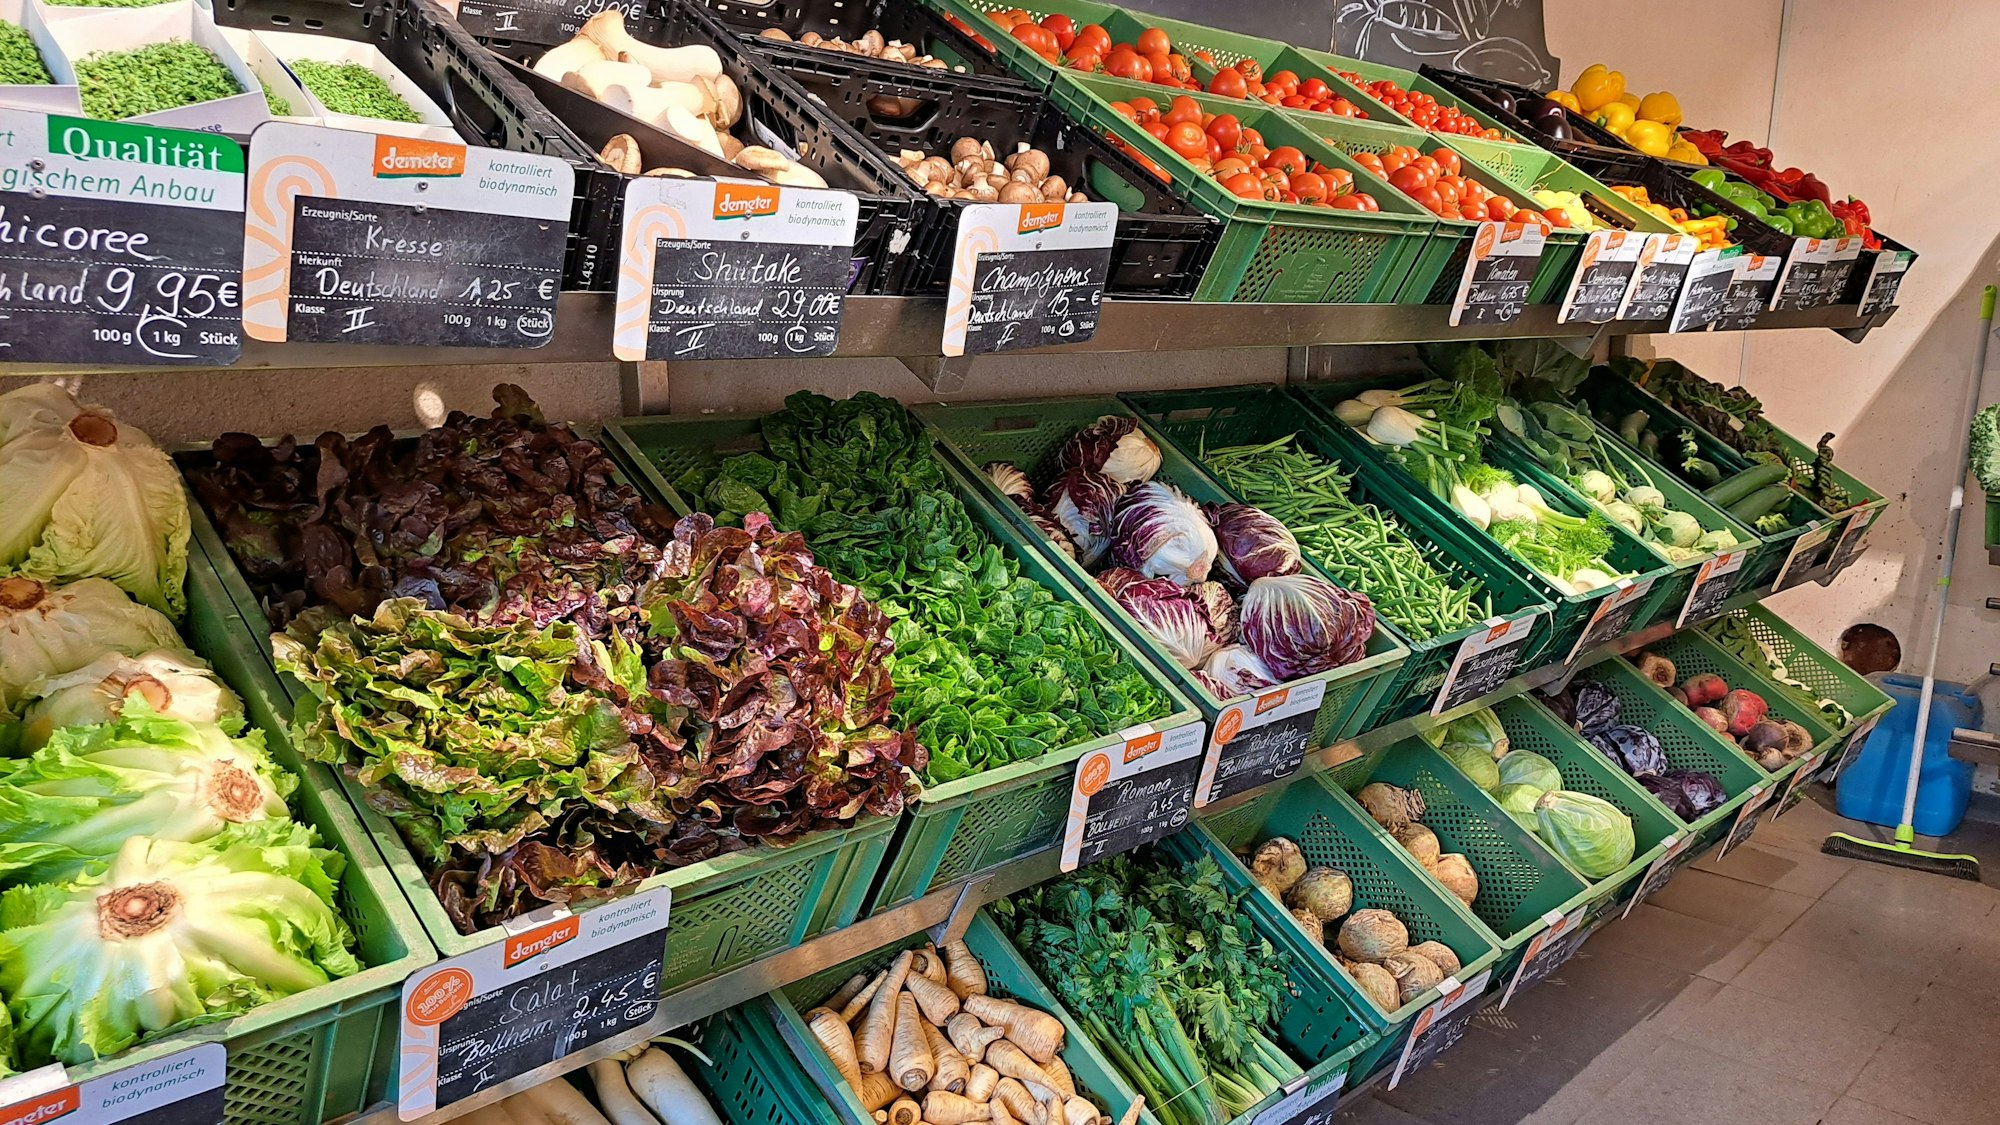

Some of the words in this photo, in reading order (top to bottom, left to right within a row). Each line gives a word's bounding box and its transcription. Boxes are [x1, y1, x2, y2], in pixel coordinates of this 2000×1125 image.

[462, 5, 483, 16] Klasse
[63, 126, 223, 172] Qualität
[380, 147, 455, 171] demeter
[488, 160, 553, 178] kontrolliert
[129, 174, 215, 203] Anbau
[479, 177, 558, 197] biodynamisch
[719, 193, 772, 213] demeter
[795, 199, 843, 211] kontrolliert
[302, 206, 378, 222] Erzeugnis/Sorte
[788, 214, 846, 227] biodynamisch
[1021, 211, 1059, 228] demeter
[1074, 211, 1107, 220] kontrolliert
[1068, 222, 1109, 234] biodynamisch
[365, 225, 444, 258] Kresse
[656, 239, 711, 250] Erzeugnis/Sorte
[299, 254, 343, 267] Herkunft
[315, 267, 443, 300] Deutschland
[538, 279, 554, 300] €
[980, 262, 1092, 298] Champignons
[652, 288, 684, 298] Ursprung
[658, 298, 763, 317] Deutschland
[967, 298, 1038, 324] Deutschland
[1091, 290, 1101, 306] €
[295, 303, 326, 315] Klasse
[342, 307, 376, 333] II
[493, 315, 508, 329] kg
[520, 316, 549, 330] Stück
[164, 329, 181, 346] kg
[200, 331, 238, 346] Stück
[648, 325, 671, 334] Klasse
[1248, 723, 1298, 752] Radicchio
[1299, 738, 1308, 750] €
[1116, 778, 1172, 805] Romana
[1182, 789, 1191, 802] €
[598, 898, 654, 923] kontrolliert
[591, 909, 657, 938] biodynamisch
[510, 926, 571, 960] demeter
[499, 969, 580, 1025] Salat
[458, 1019, 553, 1067] Bollheim
[573, 978, 638, 1020] 2,45
[642, 972, 656, 989] €
[628, 1002, 652, 1018] Stück
[439, 1037, 476, 1057] Ursprung
[111, 1057, 196, 1092] kontrolliert
[437, 1072, 463, 1087] Klasse
[102, 1066, 206, 1109] biodynamisch
